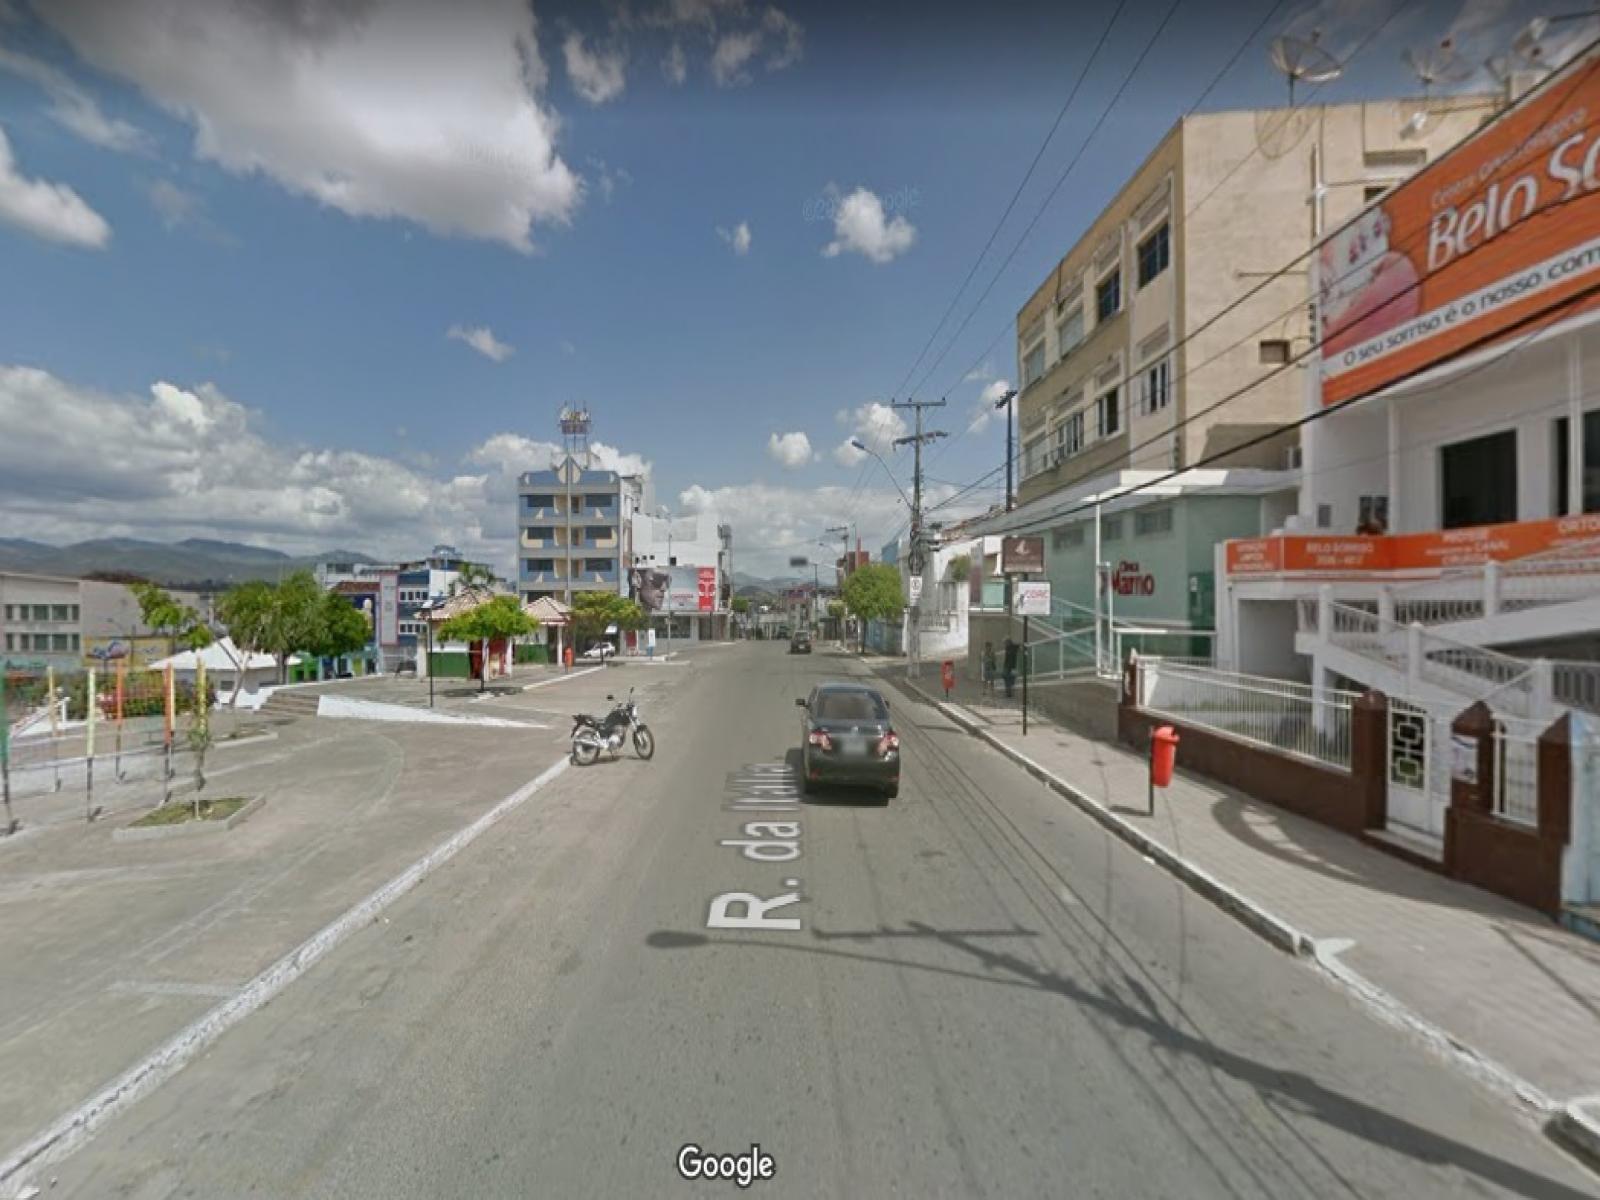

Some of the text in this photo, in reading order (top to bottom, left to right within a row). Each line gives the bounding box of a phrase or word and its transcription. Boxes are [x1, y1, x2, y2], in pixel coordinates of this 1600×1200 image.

[1427, 175, 1539, 271] Belo
[1343, 350, 1356, 366] O
[1359, 340, 1383, 360] seu
[1462, 301, 1476, 317] o
[1481, 272, 1542, 310] nosso
